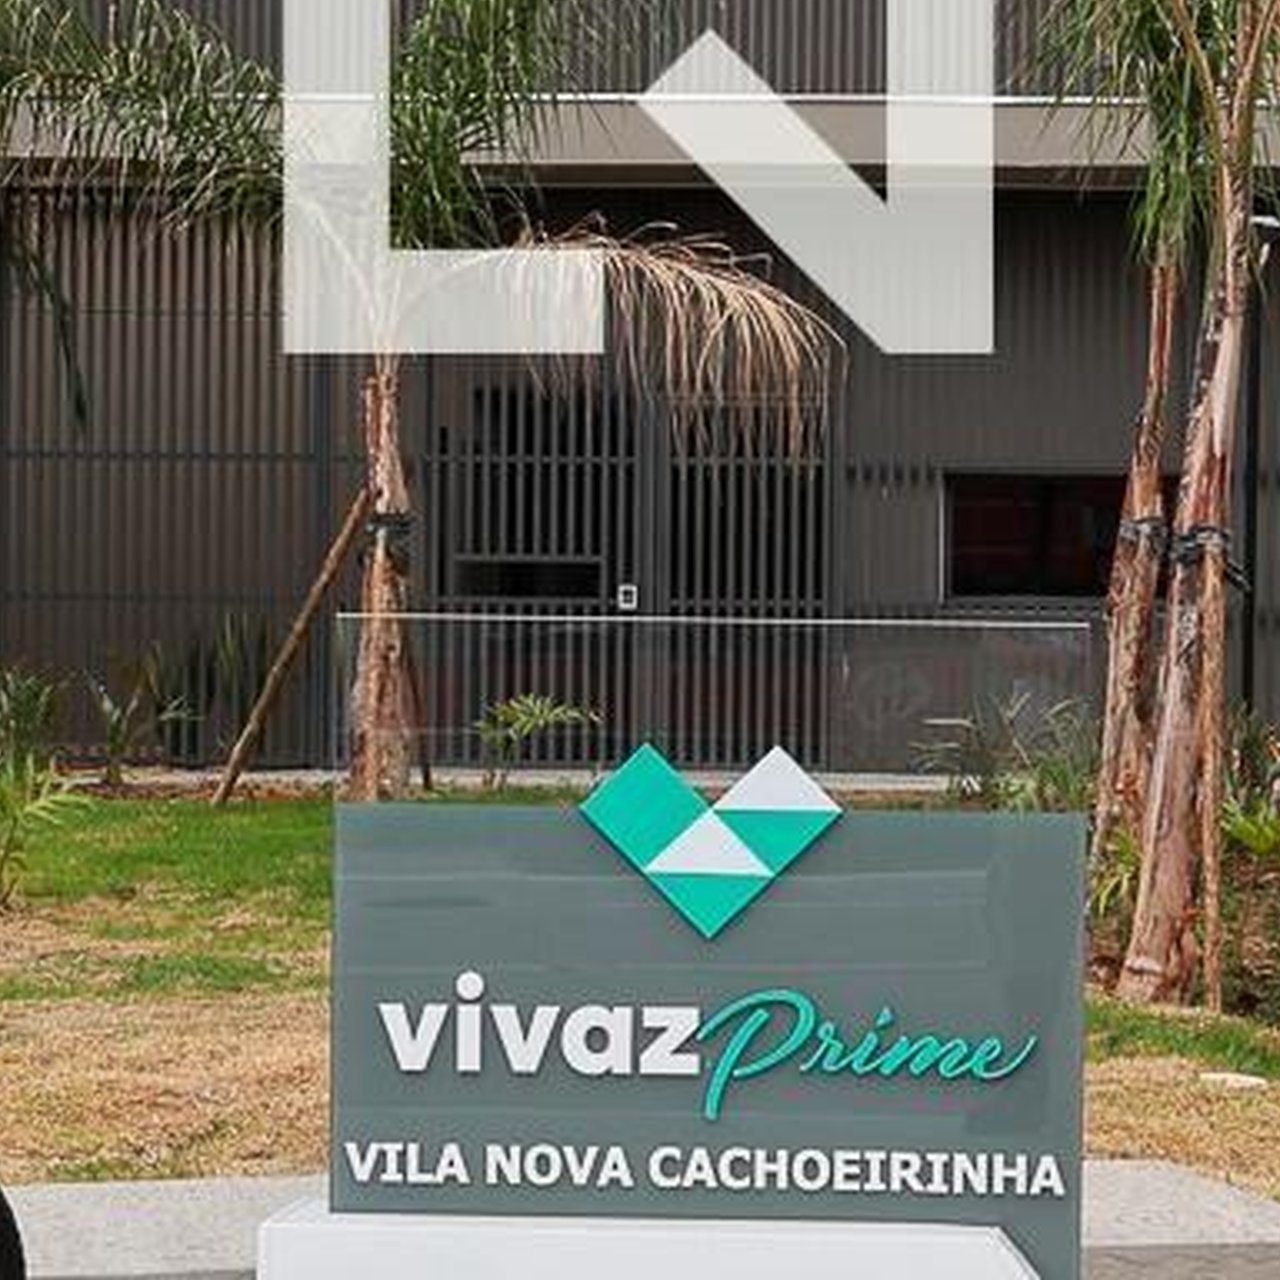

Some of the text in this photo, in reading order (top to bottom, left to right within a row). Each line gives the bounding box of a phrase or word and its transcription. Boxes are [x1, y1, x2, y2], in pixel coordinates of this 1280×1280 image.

[378, 969, 1037, 1121] vivaz Prime
[344, 1142, 1066, 1195] VILA NOVA CACHOEIRINHA
